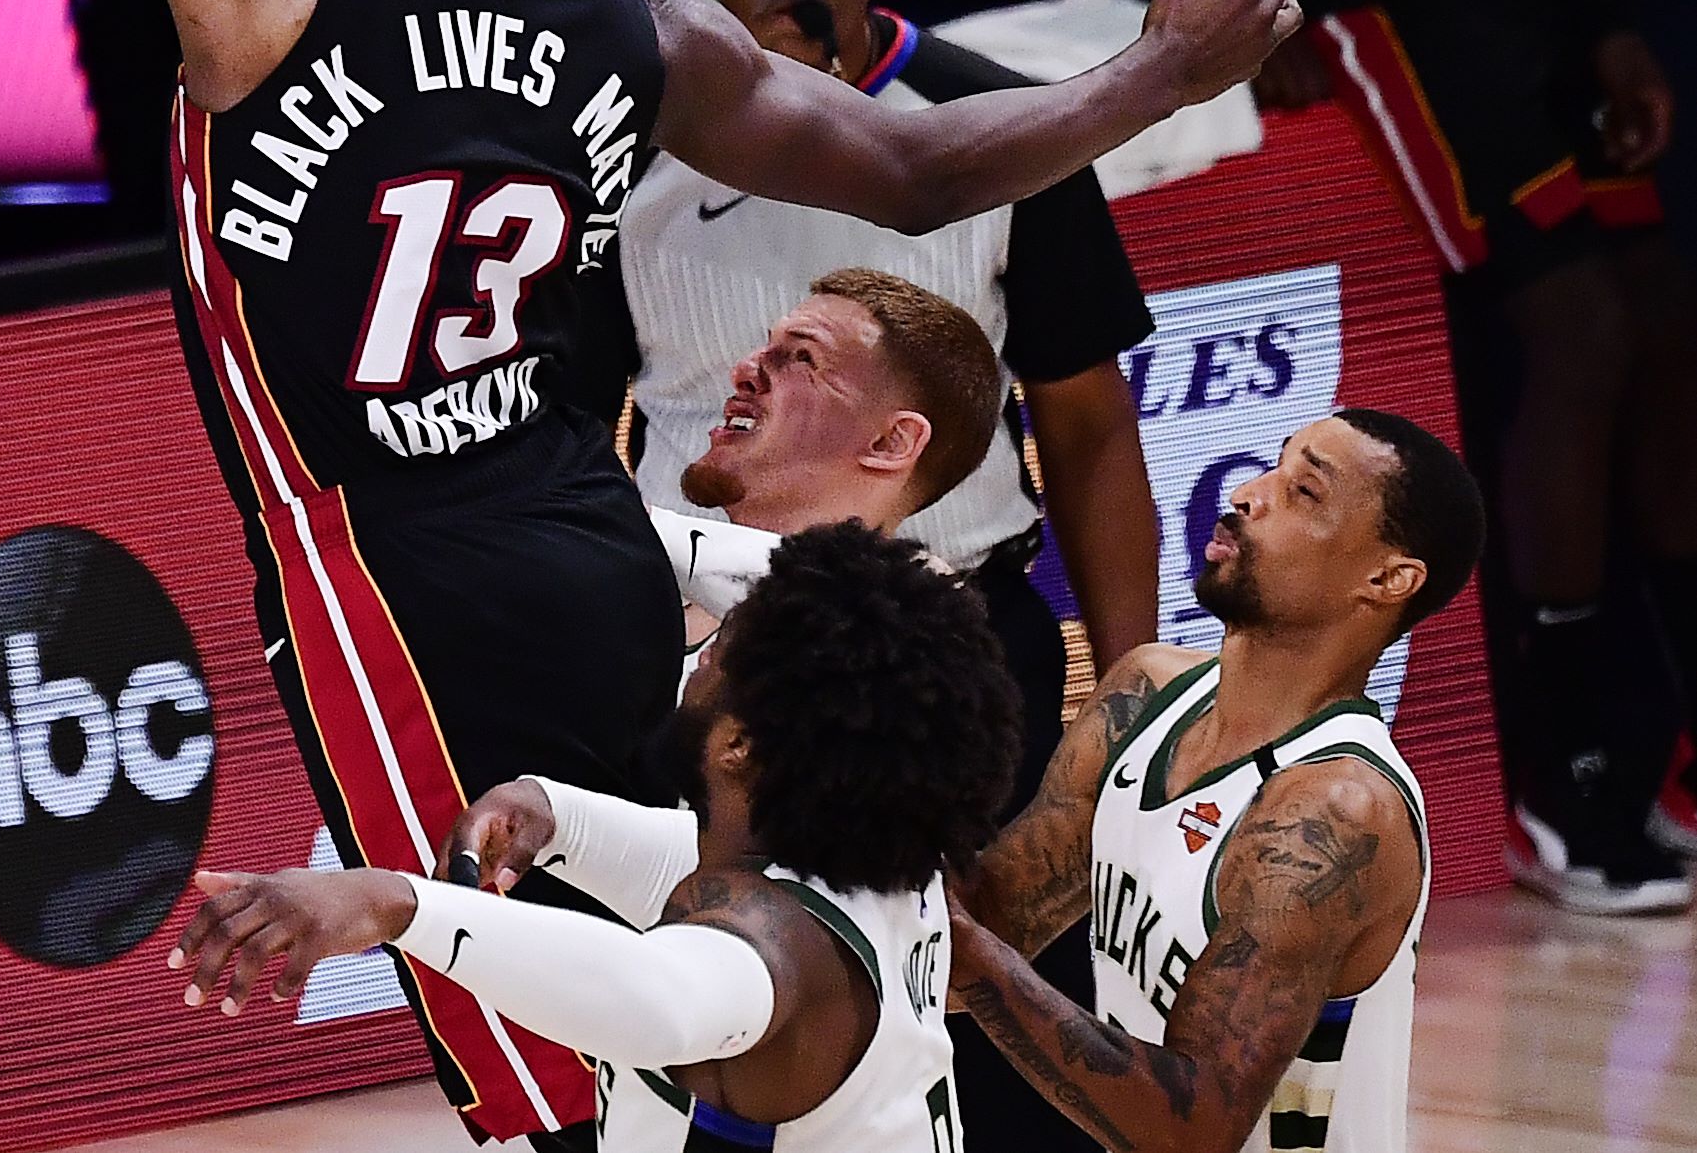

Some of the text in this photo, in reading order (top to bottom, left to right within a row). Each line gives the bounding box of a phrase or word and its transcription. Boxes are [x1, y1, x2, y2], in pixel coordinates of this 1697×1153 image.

[220, 44, 385, 262] BLACK
[405, 10, 565, 107] LIVES
[345, 170, 572, 391] 13
